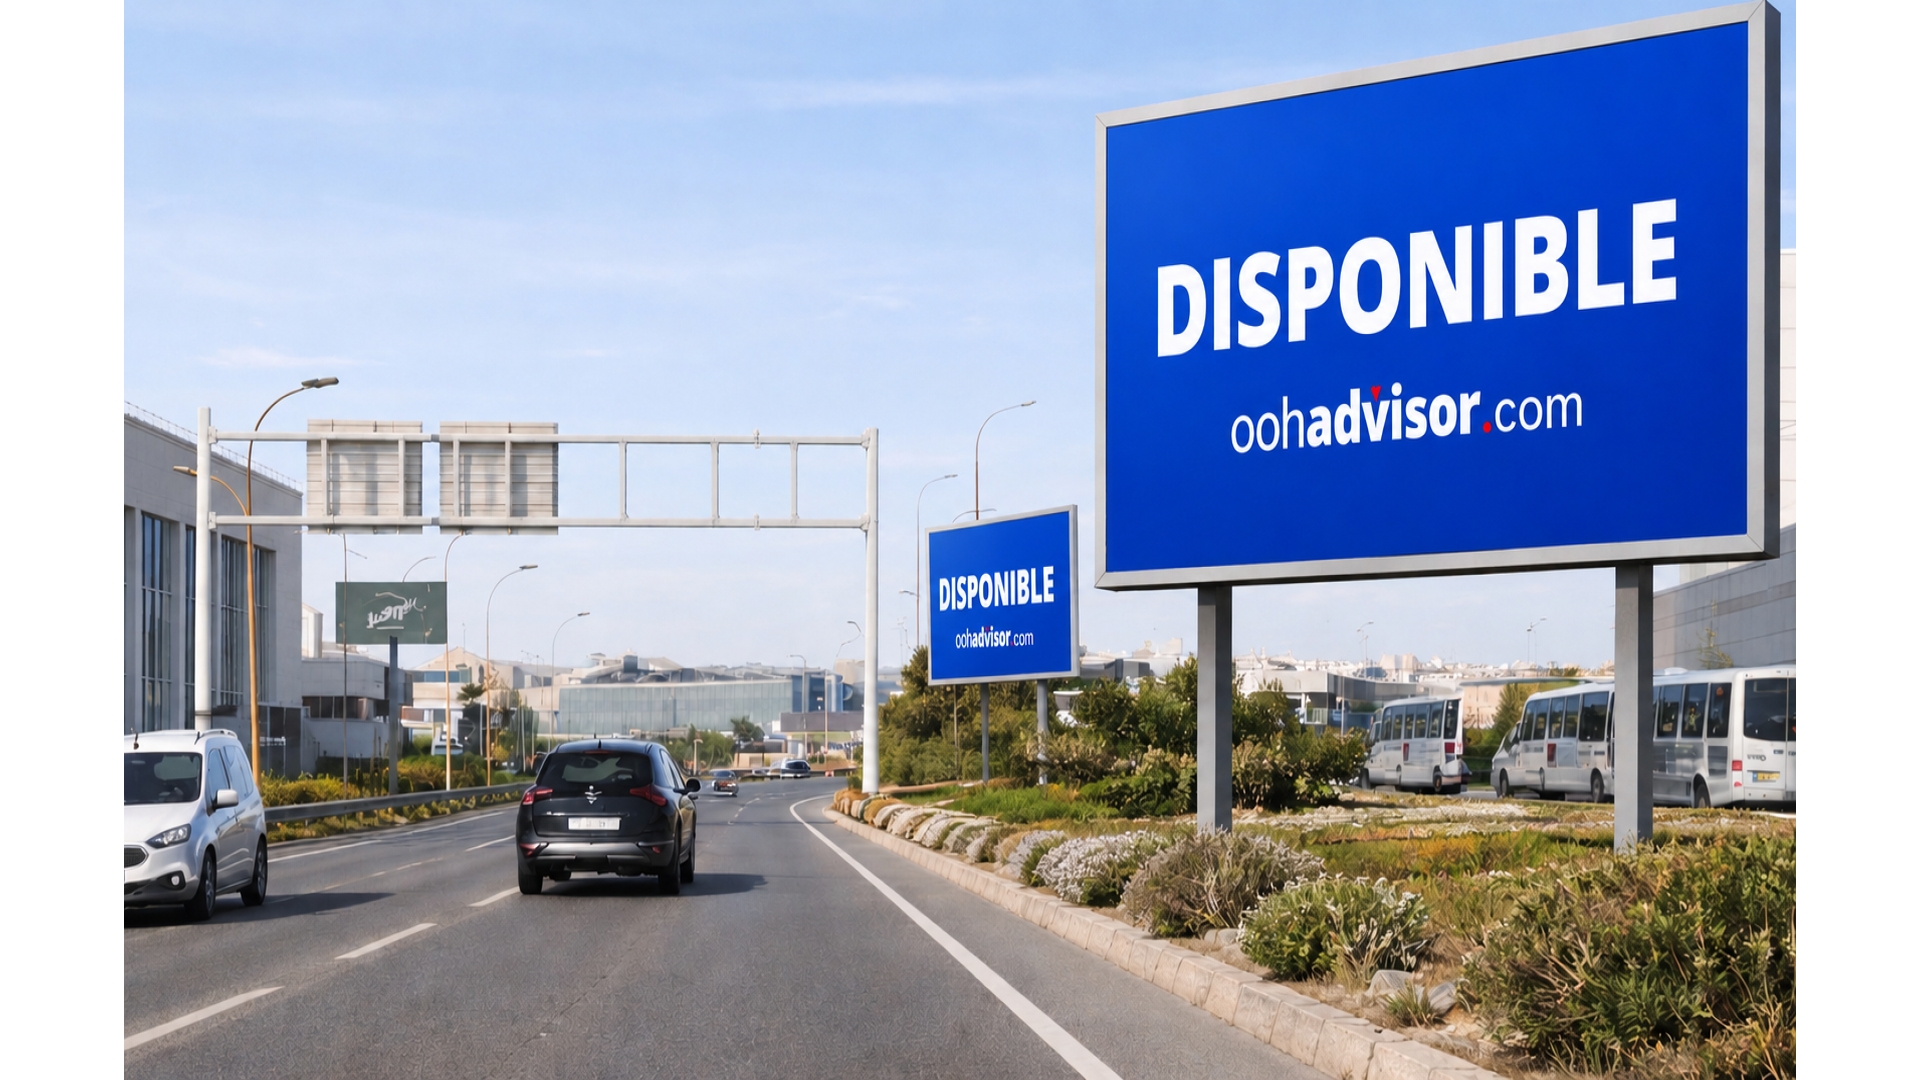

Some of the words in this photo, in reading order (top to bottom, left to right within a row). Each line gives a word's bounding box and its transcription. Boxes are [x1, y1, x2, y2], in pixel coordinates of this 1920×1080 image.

[1157, 199, 1677, 358] DISPONIBLE
[1231, 382, 1583, 453] oohadvisor.com
[939, 566, 1055, 611] DISPONIBLE
[955, 626, 1034, 649] oohadvisor.com
